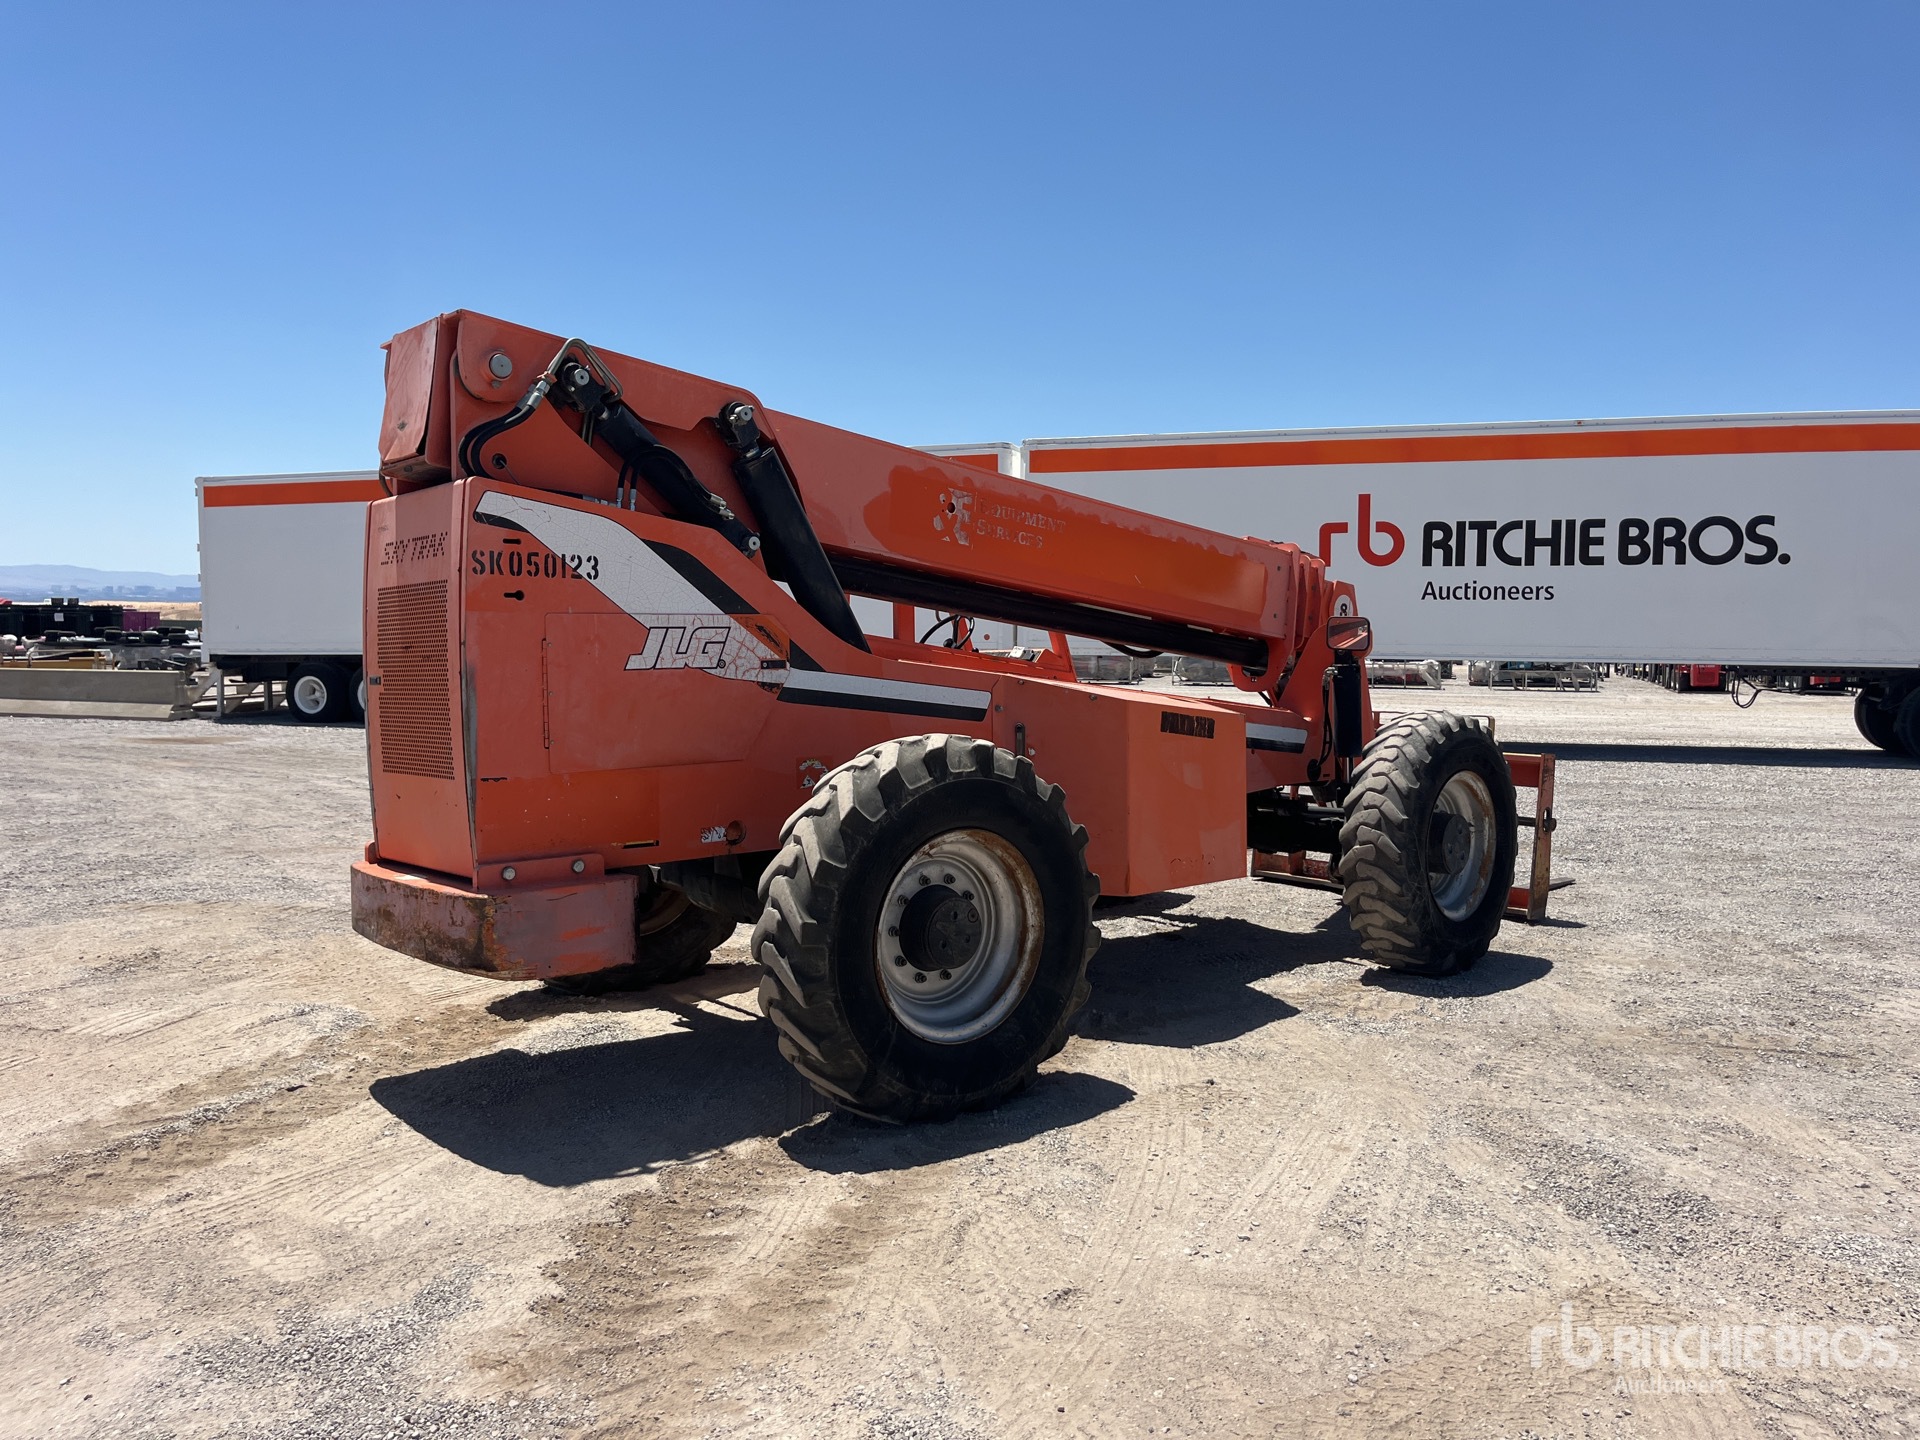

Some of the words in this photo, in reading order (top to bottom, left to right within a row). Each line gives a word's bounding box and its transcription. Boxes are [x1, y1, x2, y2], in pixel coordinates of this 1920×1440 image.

[1319, 493, 1406, 568] rb
[1421, 517, 1606, 567] RITCHIE
[1616, 514, 1792, 566] BROS.
[471, 549, 600, 581] SK050123
[1421, 580, 1556, 601] Auctioneers
